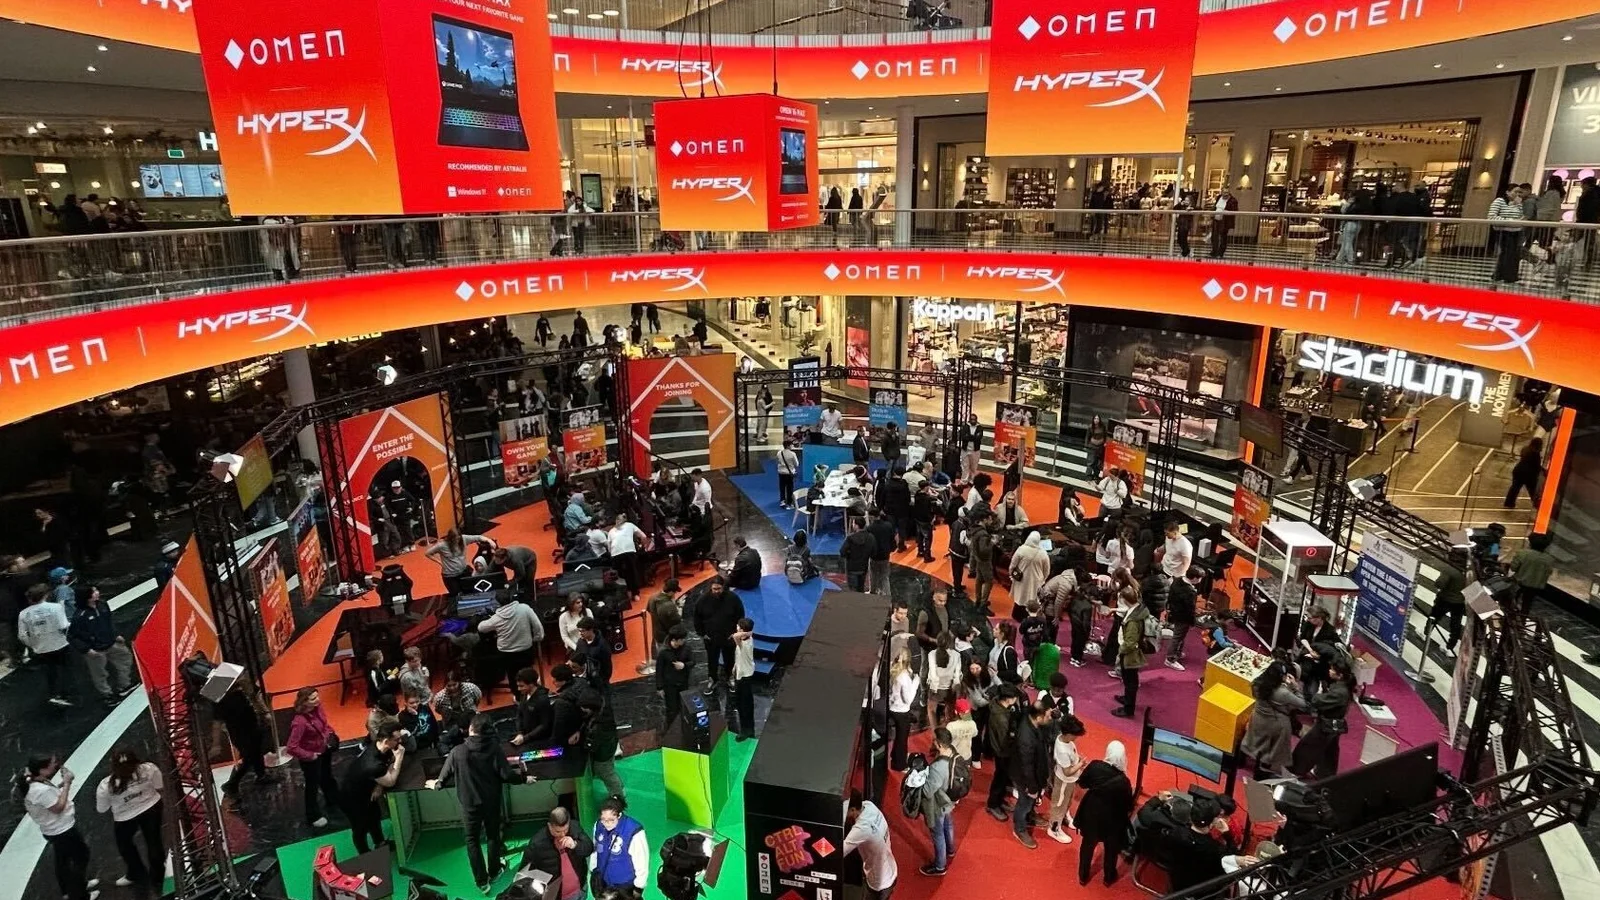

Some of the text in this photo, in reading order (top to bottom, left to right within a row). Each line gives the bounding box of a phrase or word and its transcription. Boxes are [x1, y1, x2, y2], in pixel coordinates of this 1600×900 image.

[509, 13, 524, 23] GAME
[1048, 8, 1156, 37] OMEN
[1304, 0, 1423, 37] OMEN
[250, 29, 345, 65] OMEN
[621, 57, 727, 93] HYPERX
[874, 57, 957, 78] OMEN
[1013, 65, 1166, 113] HYPERX
[1572, 86, 1600, 104] VI
[237, 103, 379, 166] HYPERX
[686, 139, 744, 155] OMEN
[447, 163, 494, 171] RECOMMENDED
[502, 165, 528, 173] ASTRALIS
[457, 187, 482, 195] Windows
[505, 187, 532, 197] OMEN
[672, 176, 756, 205] HYPERX
[480, 267, 709, 298] OMEN HYPERX
[845, 264, 1067, 298] OMEN HYPERX
[913, 297, 995, 327] Kappahl
[1229, 282, 1543, 371] OMEN HYPERX
[0, 300, 317, 384] MEN HYPERX
[1299, 337, 1484, 405] stadium
[655, 382, 685, 391] THANKS
[664, 389, 693, 397] JOINING
[1482, 386, 1497, 404] THE
[372, 433, 415, 452] ENTER THE
[376, 443, 413, 461] POSSIBLE
[506, 443, 546, 455] OWN YOUR
[516, 450, 537, 459] GAME
[1376, 567, 1386, 580] THE
[1368, 582, 1378, 594] THE
[764, 825, 802, 847] CTRL
[776, 840, 798, 854] ALT
[778, 850, 805, 868] FUN
[760, 862, 769, 893] OMEN
